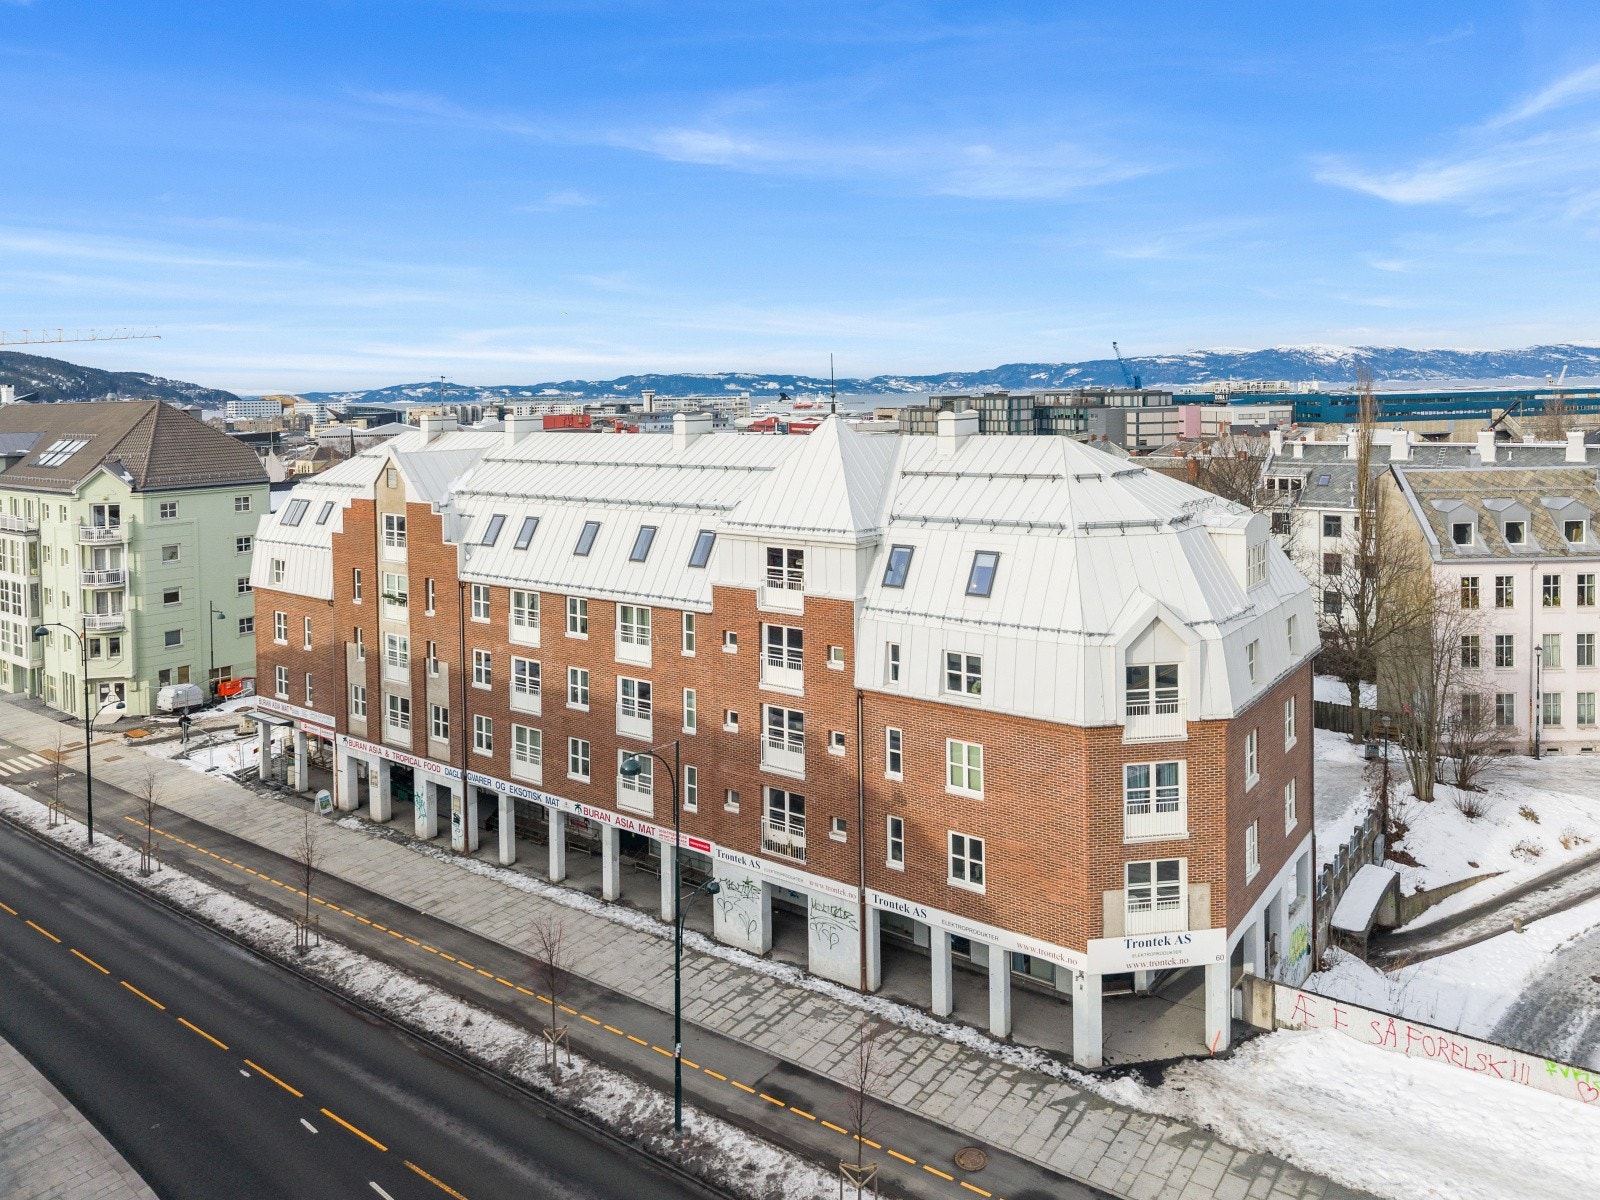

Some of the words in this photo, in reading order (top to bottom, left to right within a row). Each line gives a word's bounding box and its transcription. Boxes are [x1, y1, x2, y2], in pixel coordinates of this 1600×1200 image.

[348, 739, 367, 751] BURAN
[368, 745, 382, 755] ASIA
[384, 750, 389, 758] &
[392, 752, 421, 767] TROPICAL
[423, 761, 440, 773] FOOD
[444, 768, 492, 786] DAGLGVARER
[495, 781, 506, 791] OG
[509, 785, 542, 802] EKSOTISK
[545, 795, 560, 807] MAT
[583, 807, 611, 822] BURAN
[615, 817, 635, 829] ASIA
[638, 823, 656, 836] MAT
[715, 848, 747, 866] Trontek
[748, 859, 761, 870] AS
[809, 880, 857, 900] www.trontek.no
[872, 894, 910, 914] Trontek
[912, 907, 927, 919] AS
[941, 919, 999, 942] ELEKTROPRODUKTER
[1016, 941, 1078, 966] www.trontek.no
[1124, 936, 1171, 949] Trontek
[1174, 934, 1192, 945] AS
[1126, 957, 1189, 969] www.trontek.no
